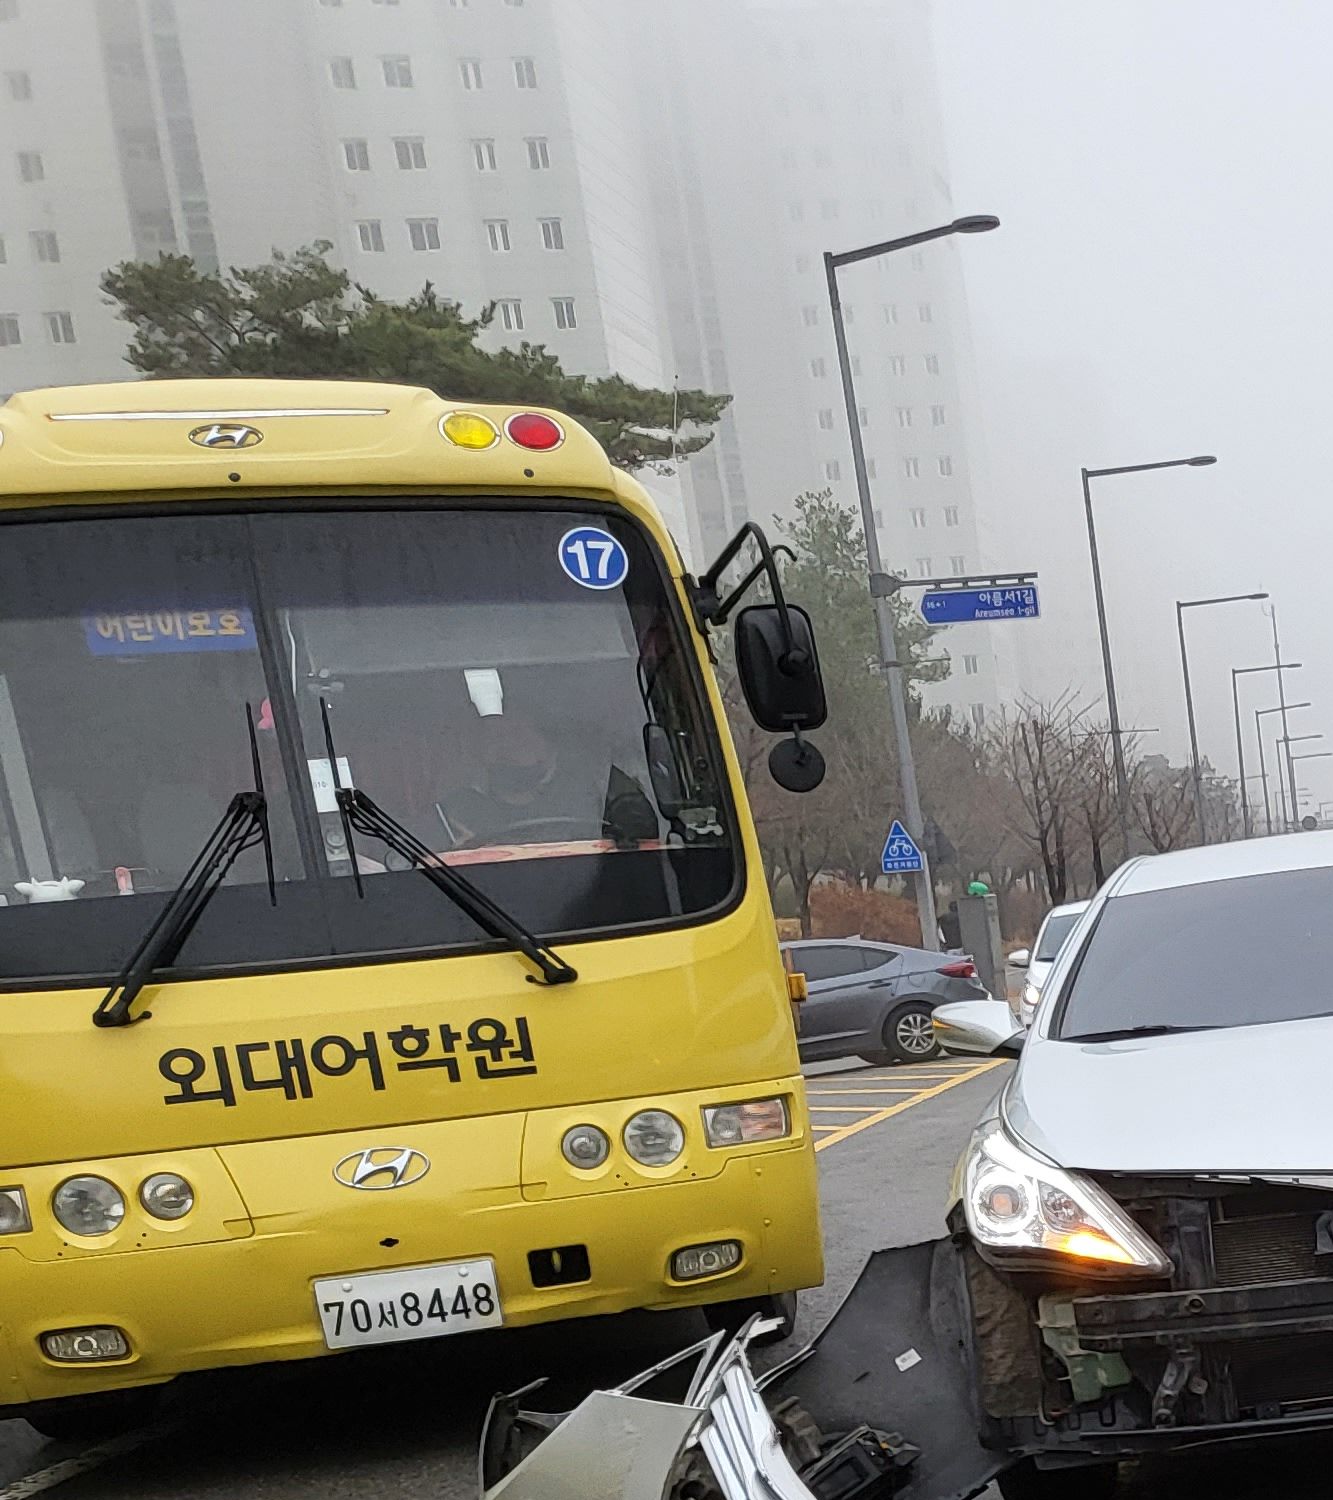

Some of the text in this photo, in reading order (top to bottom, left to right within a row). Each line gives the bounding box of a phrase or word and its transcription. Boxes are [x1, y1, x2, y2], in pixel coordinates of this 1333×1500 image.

[566, 540, 614, 579] 17
[975, 607, 1015, 618] Areumseo
[979, 588, 1035, 606] 아름서1길
[158, 1016, 538, 1107] 외대어학원
[323, 1282, 495, 1336] 70서8448
